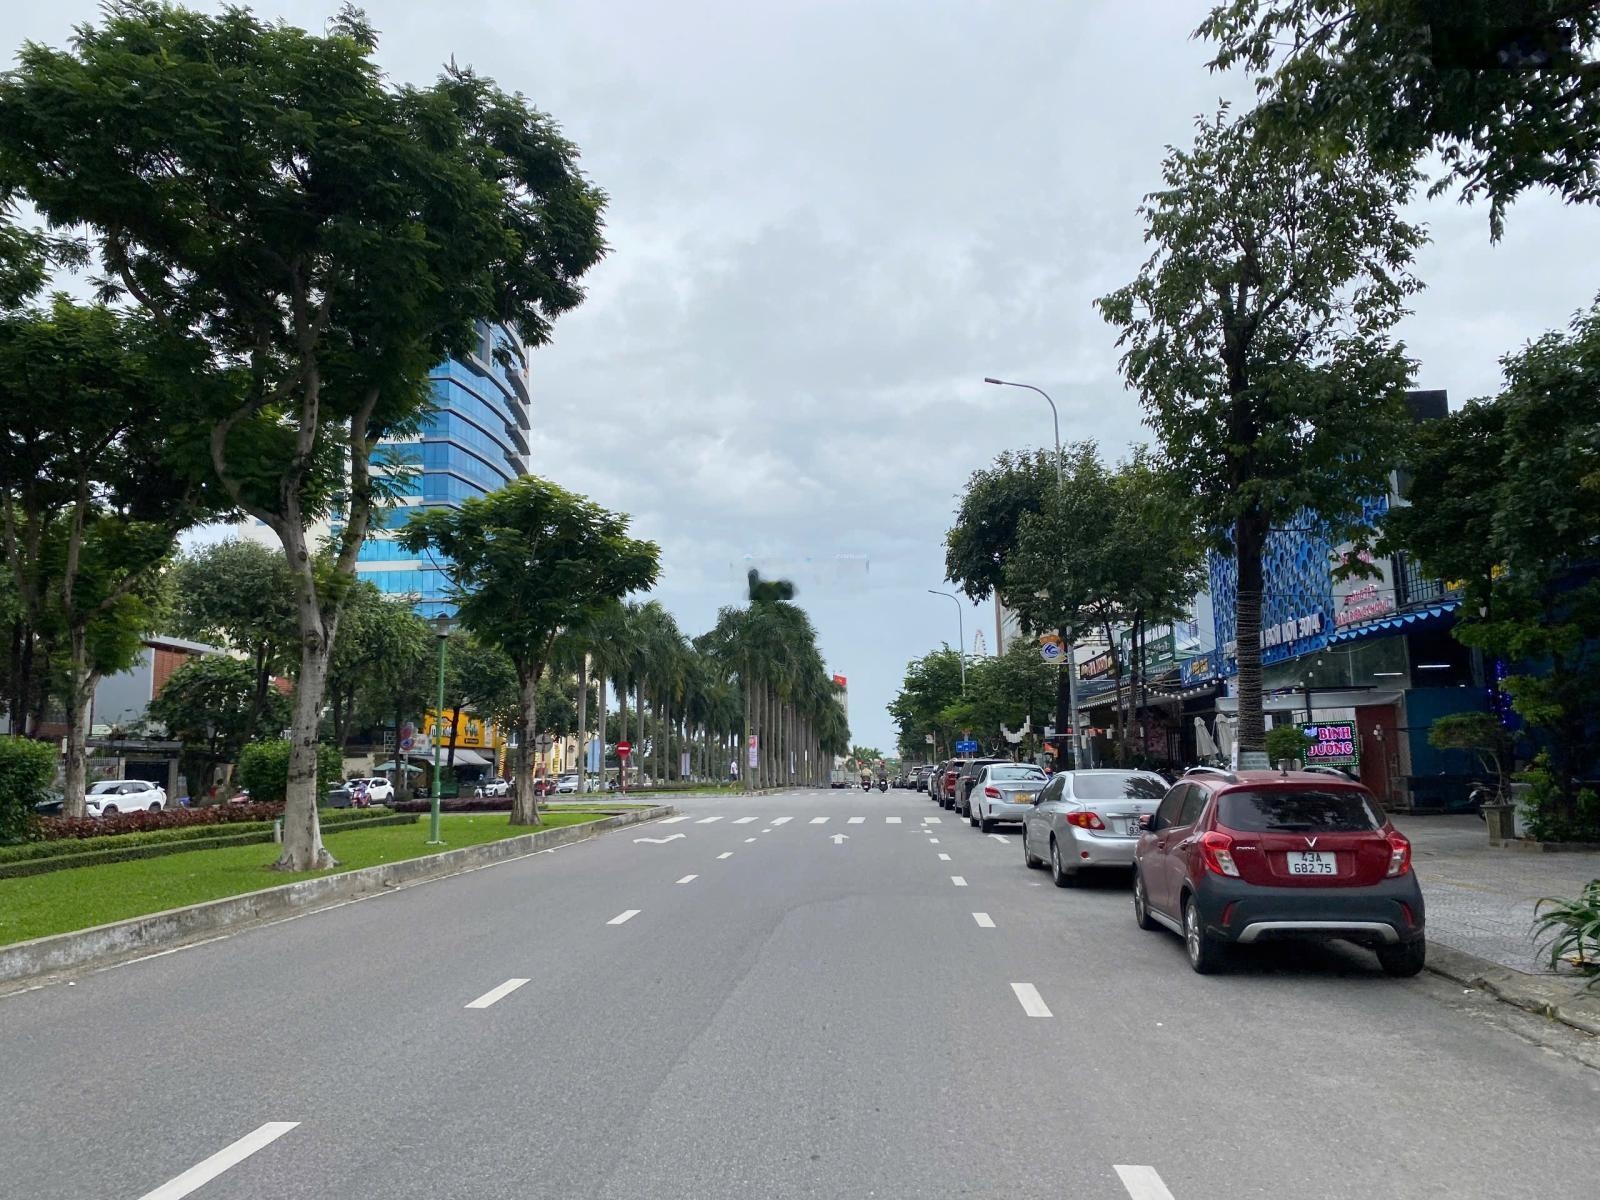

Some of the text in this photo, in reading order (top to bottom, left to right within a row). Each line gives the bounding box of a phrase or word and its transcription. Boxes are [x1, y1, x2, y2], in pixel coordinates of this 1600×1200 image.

[1318, 725, 1352, 740] BÌNH
[1301, 852, 1322, 863] 43A
[1294, 863, 1332, 874] 682.75
